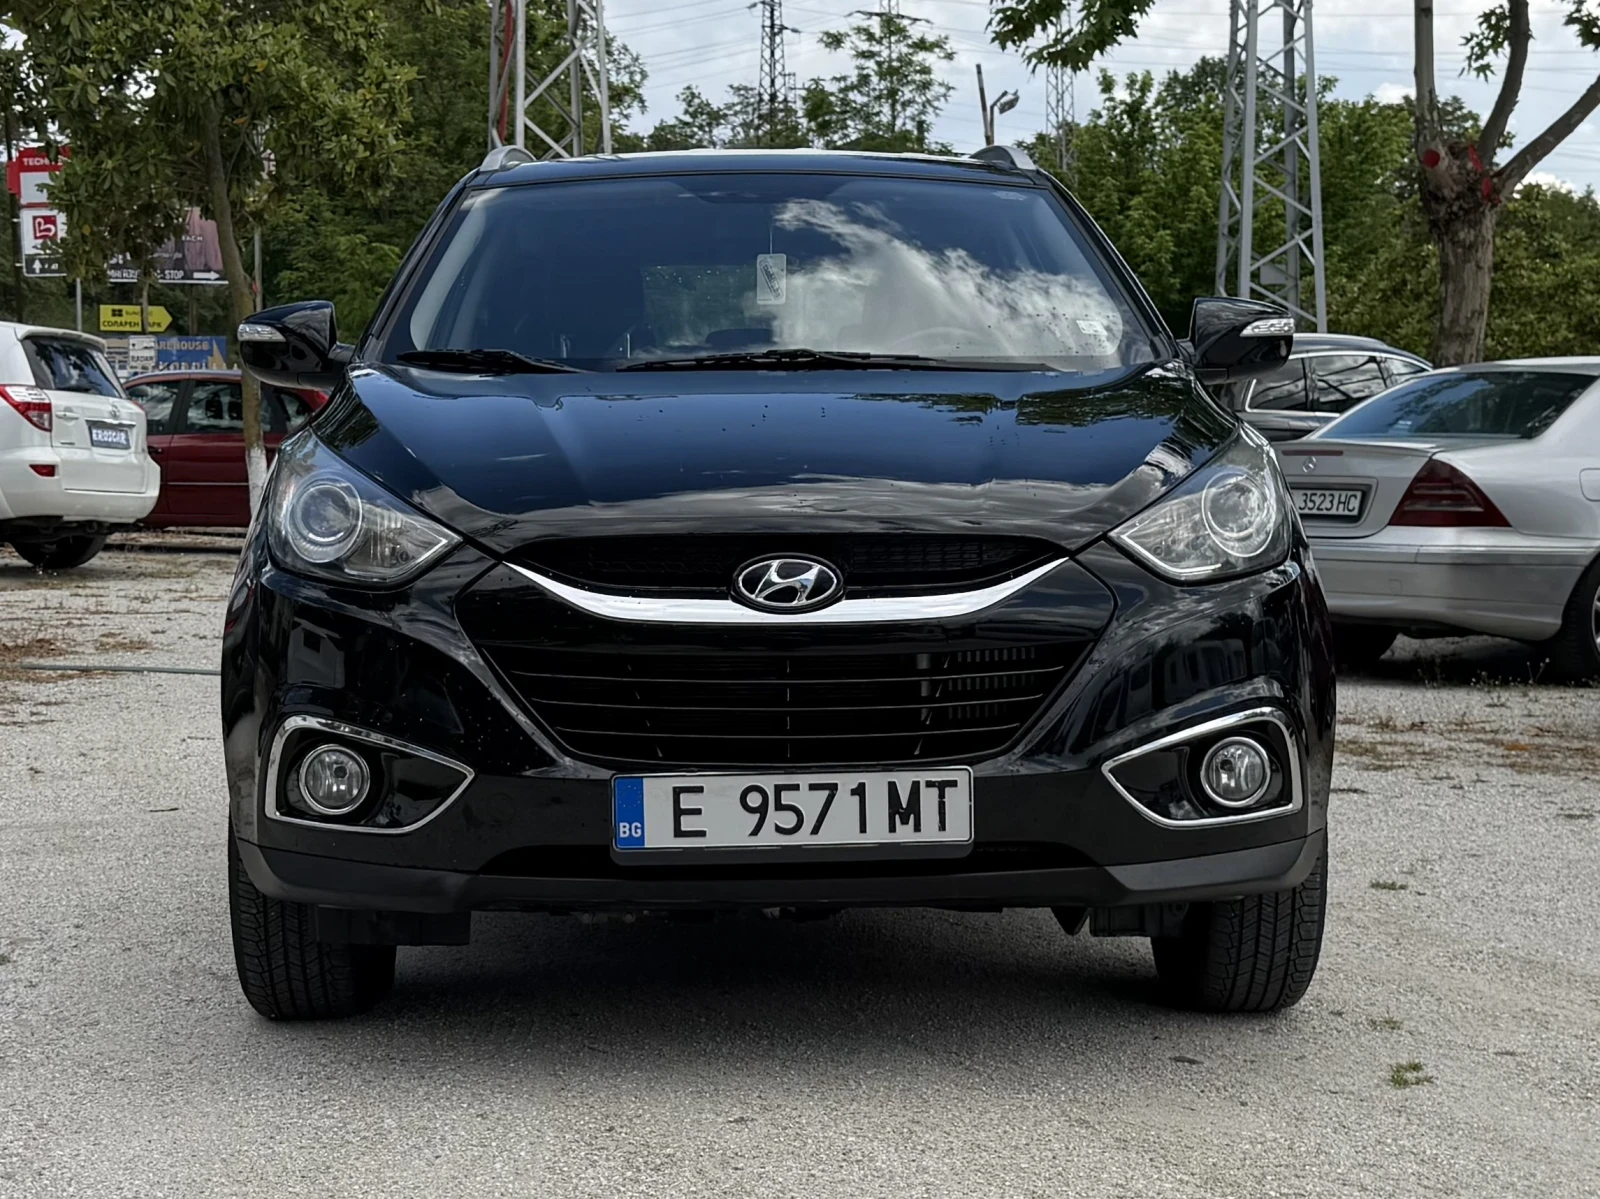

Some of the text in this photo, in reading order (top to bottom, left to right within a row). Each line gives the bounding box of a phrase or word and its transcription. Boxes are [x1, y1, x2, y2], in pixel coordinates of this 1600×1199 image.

[102, 320, 140, 328] СОЛАРЕН
[156, 340, 210, 352] AREHOUSE
[672, 779, 959, 839] E 9571 MT
[618, 822, 642, 838] BG
